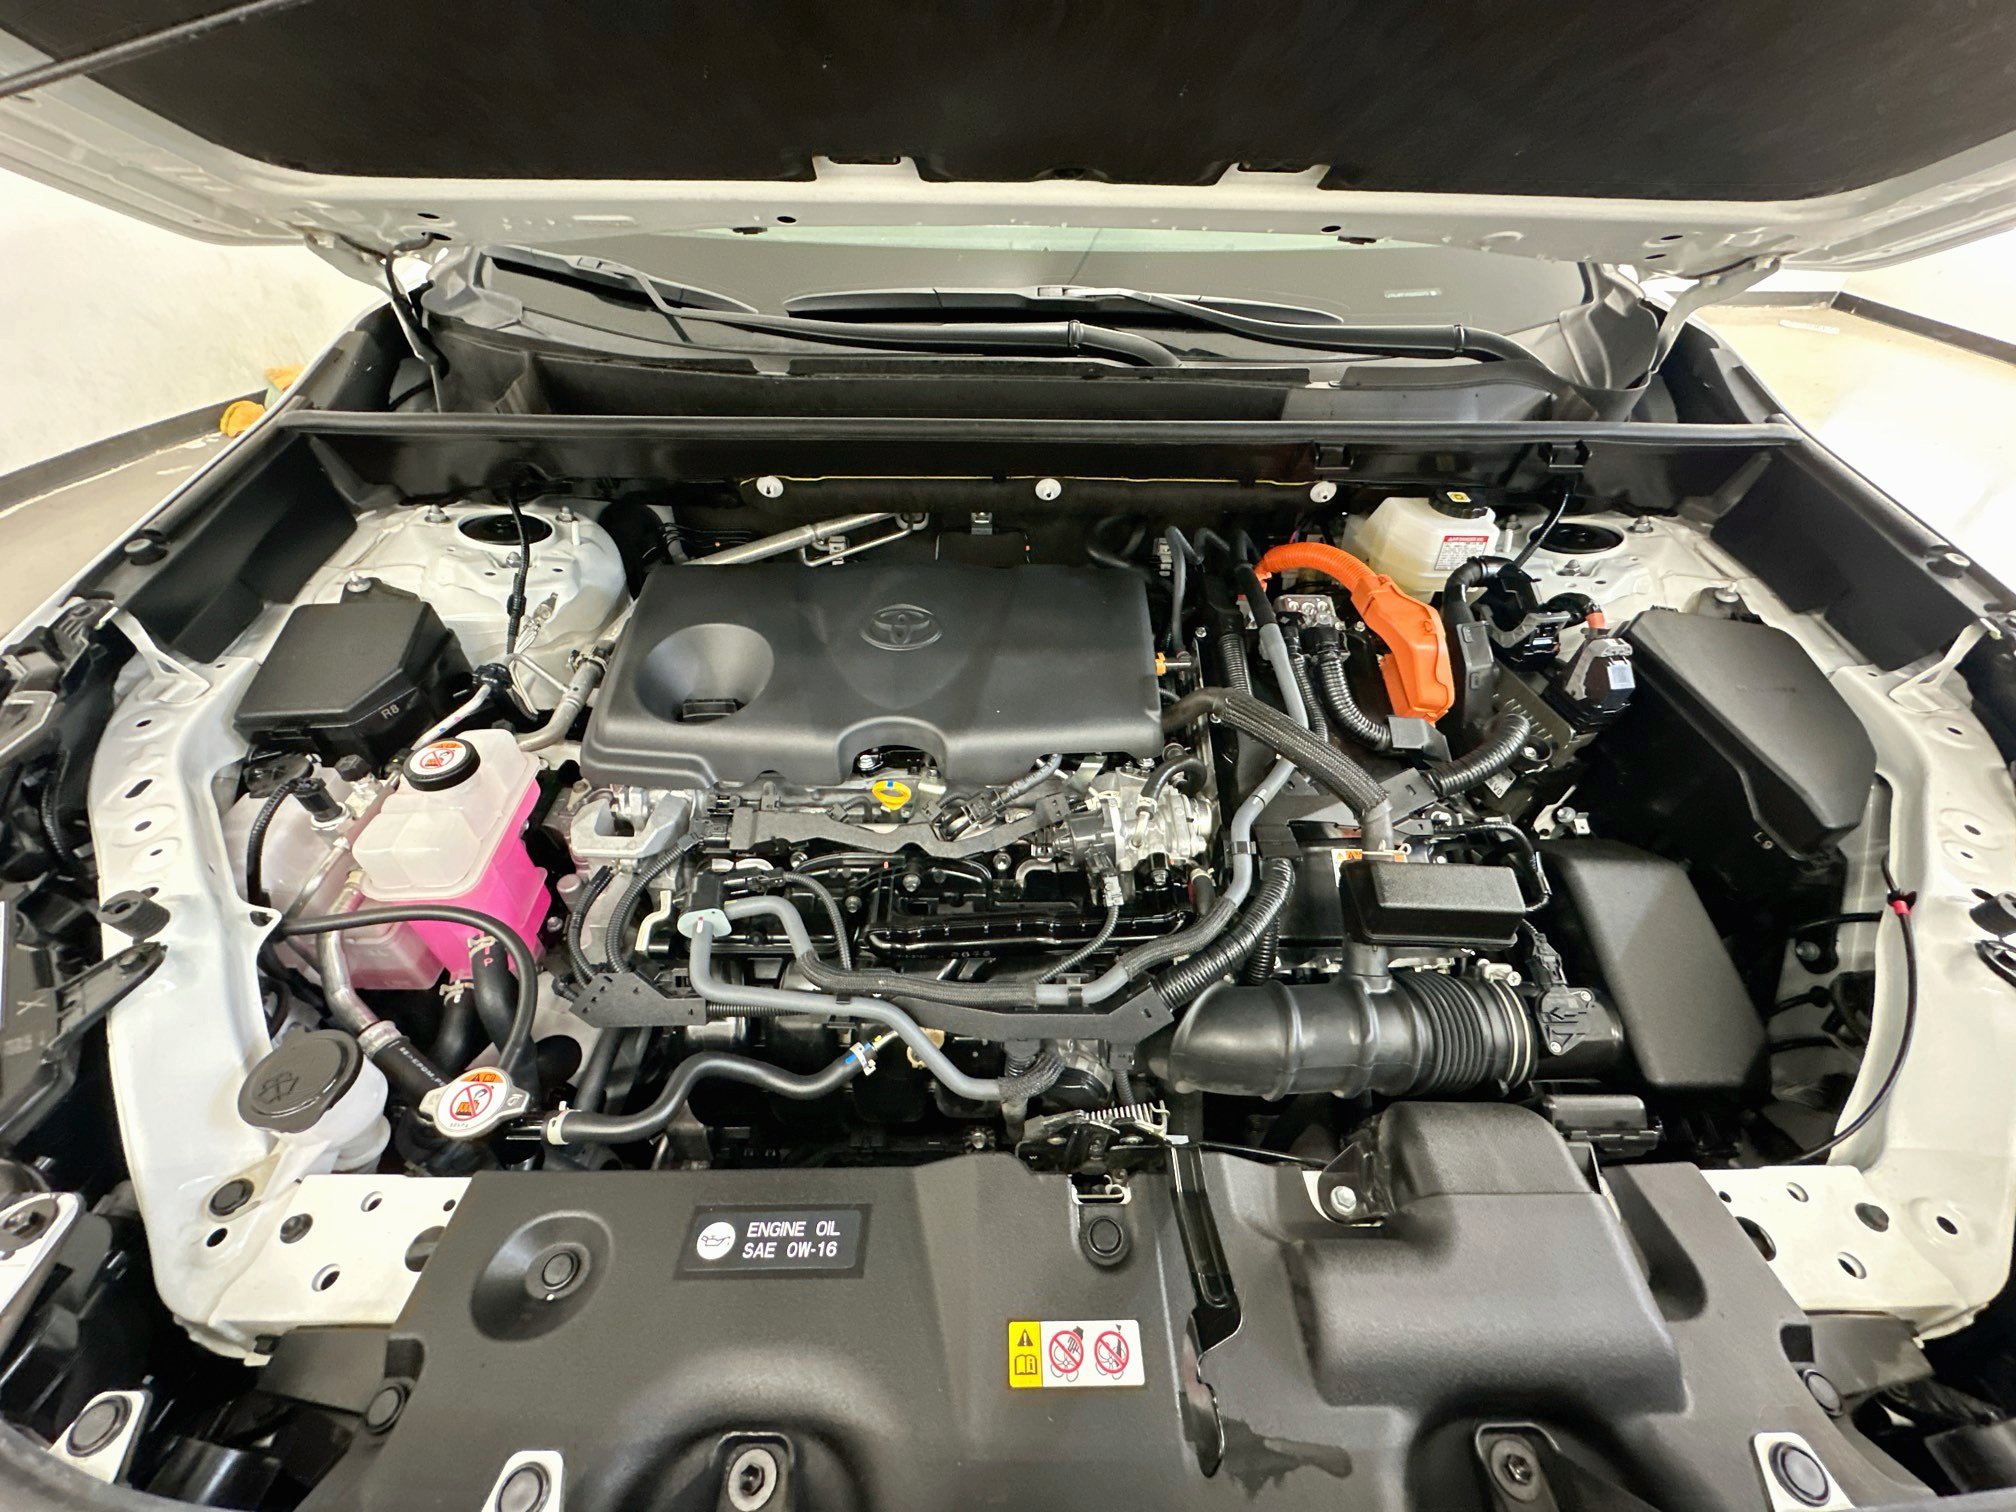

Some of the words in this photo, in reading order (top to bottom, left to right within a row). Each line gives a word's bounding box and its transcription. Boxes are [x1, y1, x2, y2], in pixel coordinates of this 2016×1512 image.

[380, 704, 399, 719] R8
[746, 1221, 807, 1237] ENGINE
[815, 1220, 840, 1236] OIL
[742, 1241, 777, 1258] SAE
[786, 1241, 838, 1258] 0W-16
